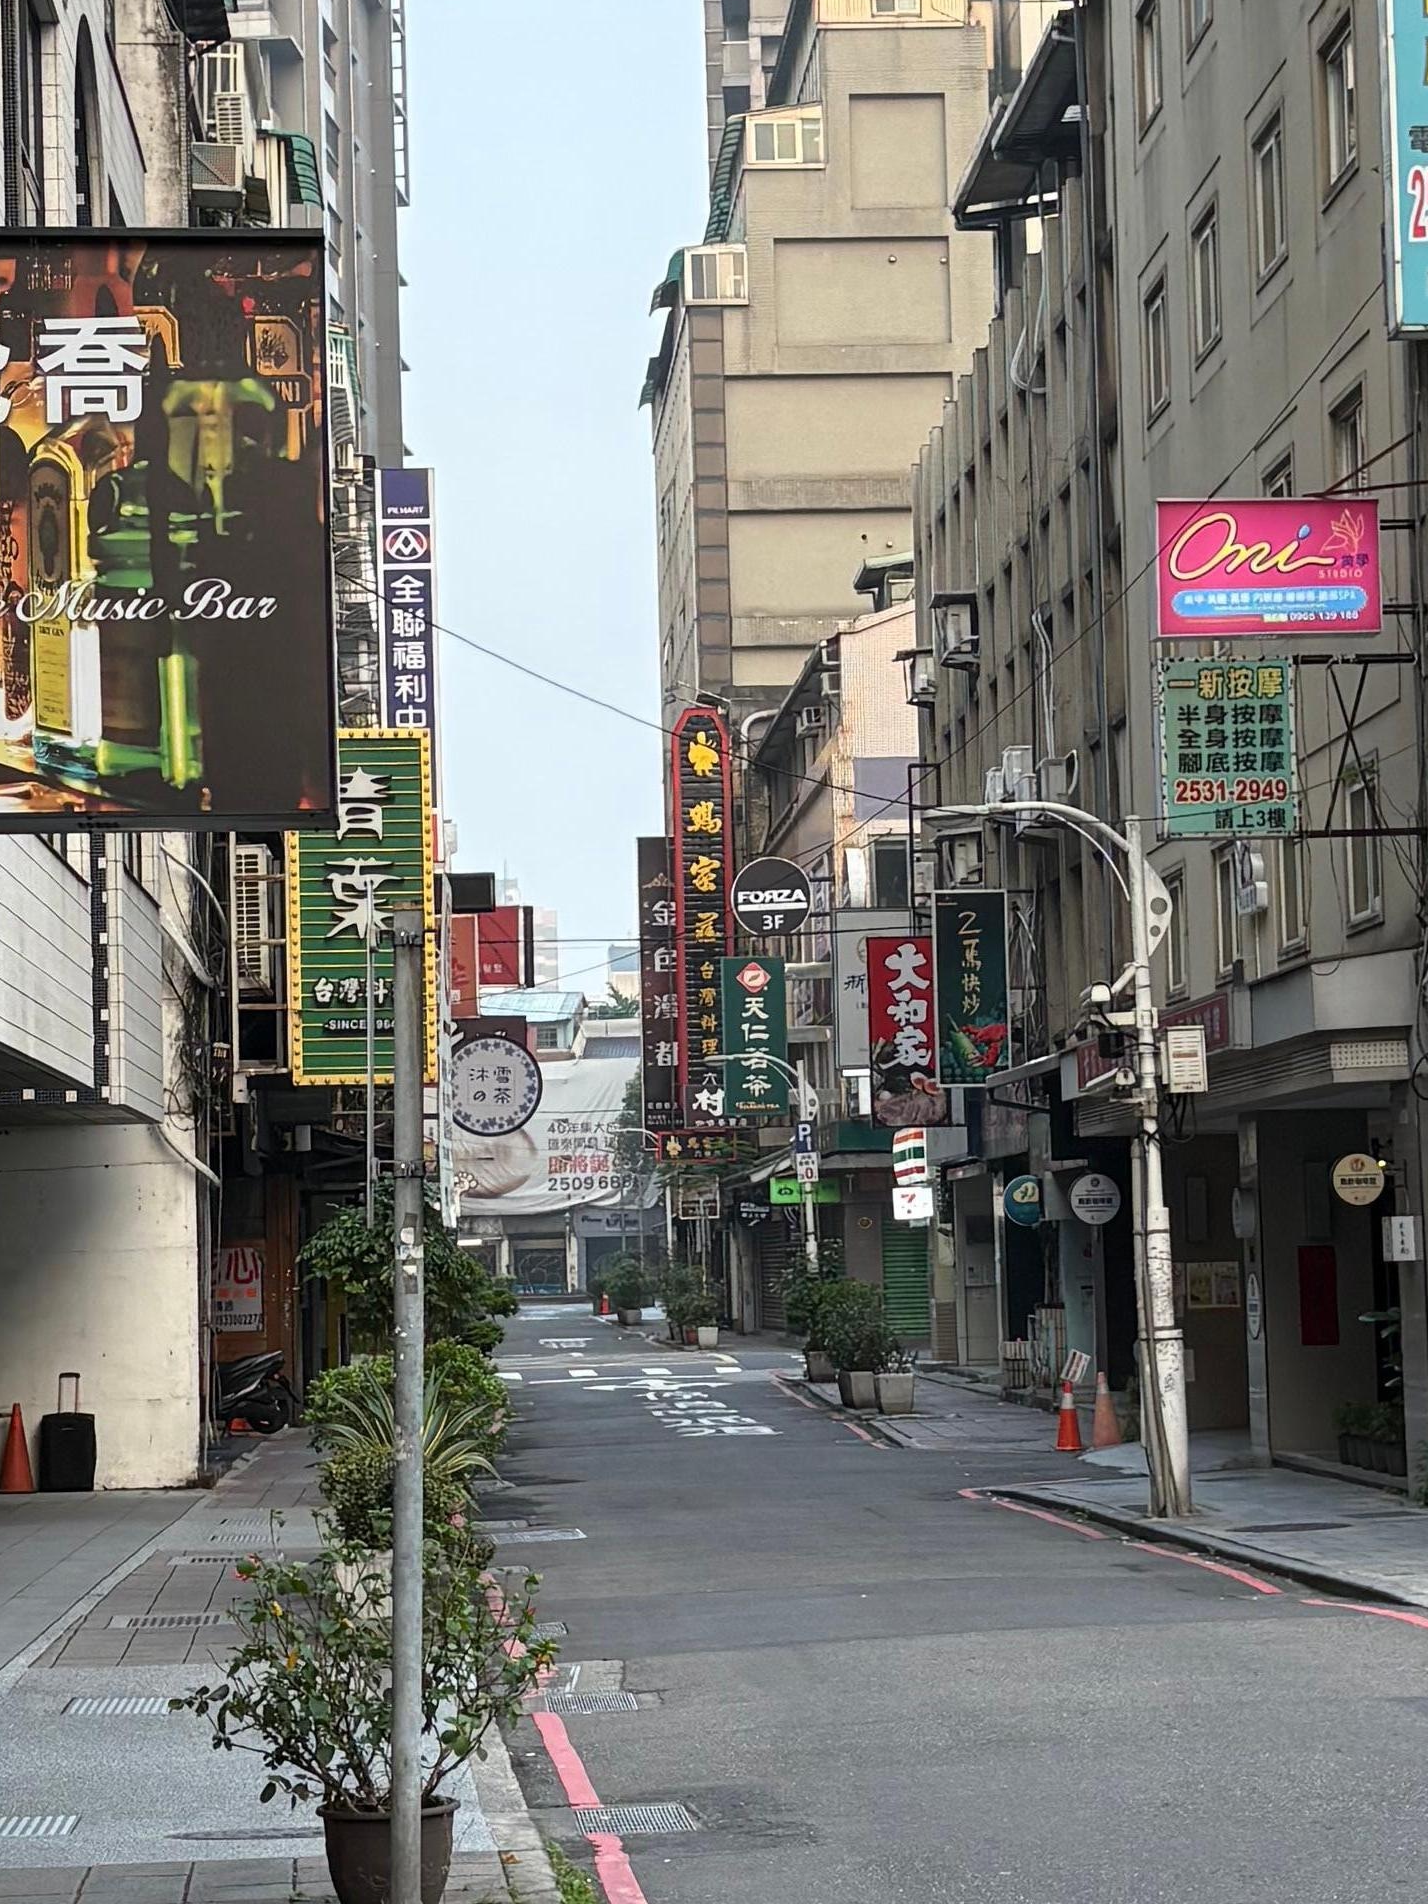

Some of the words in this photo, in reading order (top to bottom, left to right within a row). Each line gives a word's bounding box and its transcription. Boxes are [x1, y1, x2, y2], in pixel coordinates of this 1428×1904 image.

[14, 586, 166, 624] Music
[174, 578, 278, 622] Bar
[1168, 668, 1284, 700] 一新按摩
[1177, 704, 1283, 726] 半身按摩
[1177, 728, 1285, 750] 全身按摩
[1175, 778, 1288, 804] 2531-2949
[1215, 808, 1286, 829] 請上3樓
[762, 915, 784, 930] 3F
[313, 977, 395, 1005] 台灣料
[699, 961, 719, 1055] 台灣料理
[880, 943, 932, 1069] 大和家
[739, 996, 772, 1098] 天仁茗茶
[798, 1124, 811, 1141] P
[548, 1176, 594, 1191] 2509
